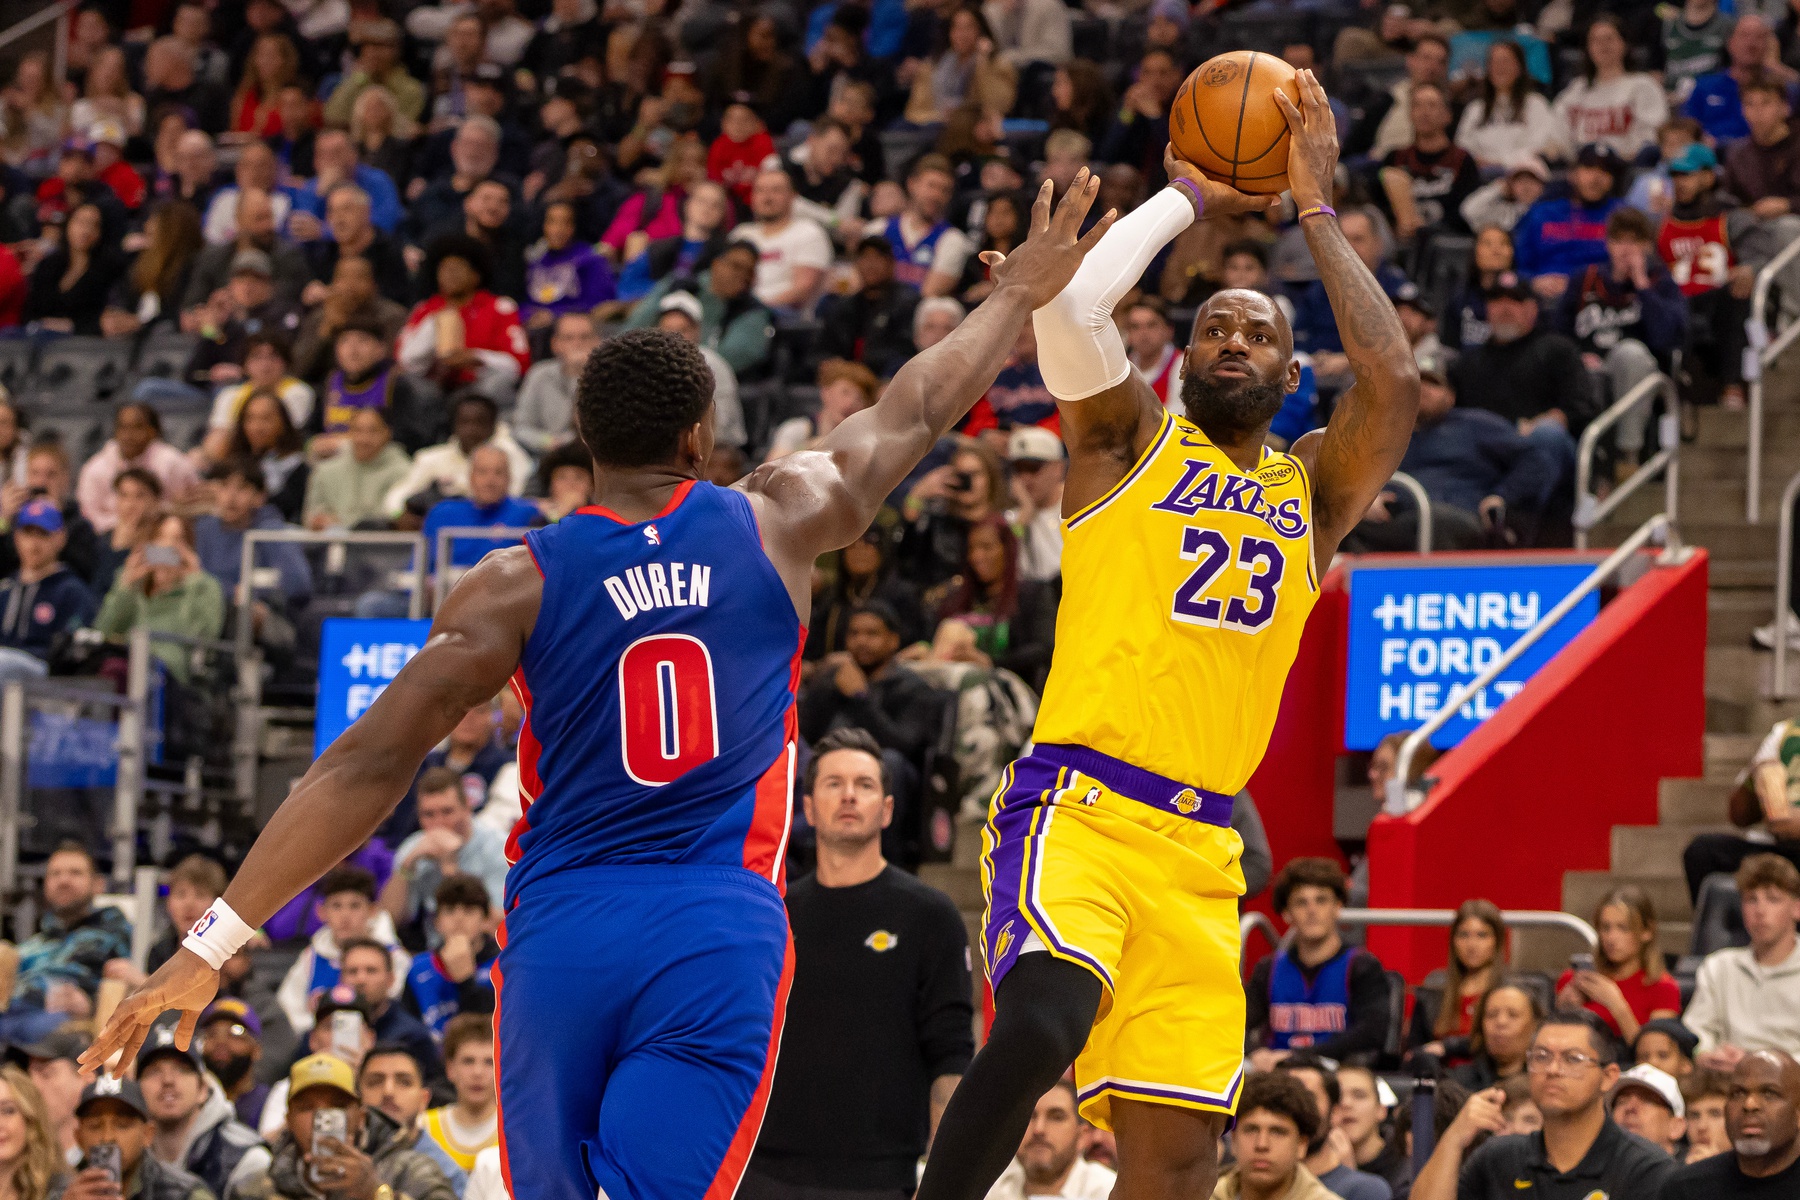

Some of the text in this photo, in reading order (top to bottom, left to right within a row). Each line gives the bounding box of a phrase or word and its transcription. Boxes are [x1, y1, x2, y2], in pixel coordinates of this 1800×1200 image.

[1150, 458, 1308, 540] LAKERS
[603, 562, 711, 621] DUREN
[1171, 525, 1286, 635] 23
[1373, 591, 1541, 631] HENRY
[1381, 636, 1503, 676] FORD
[618, 633, 719, 787] 0
[1380, 680, 1526, 720] HEALT
